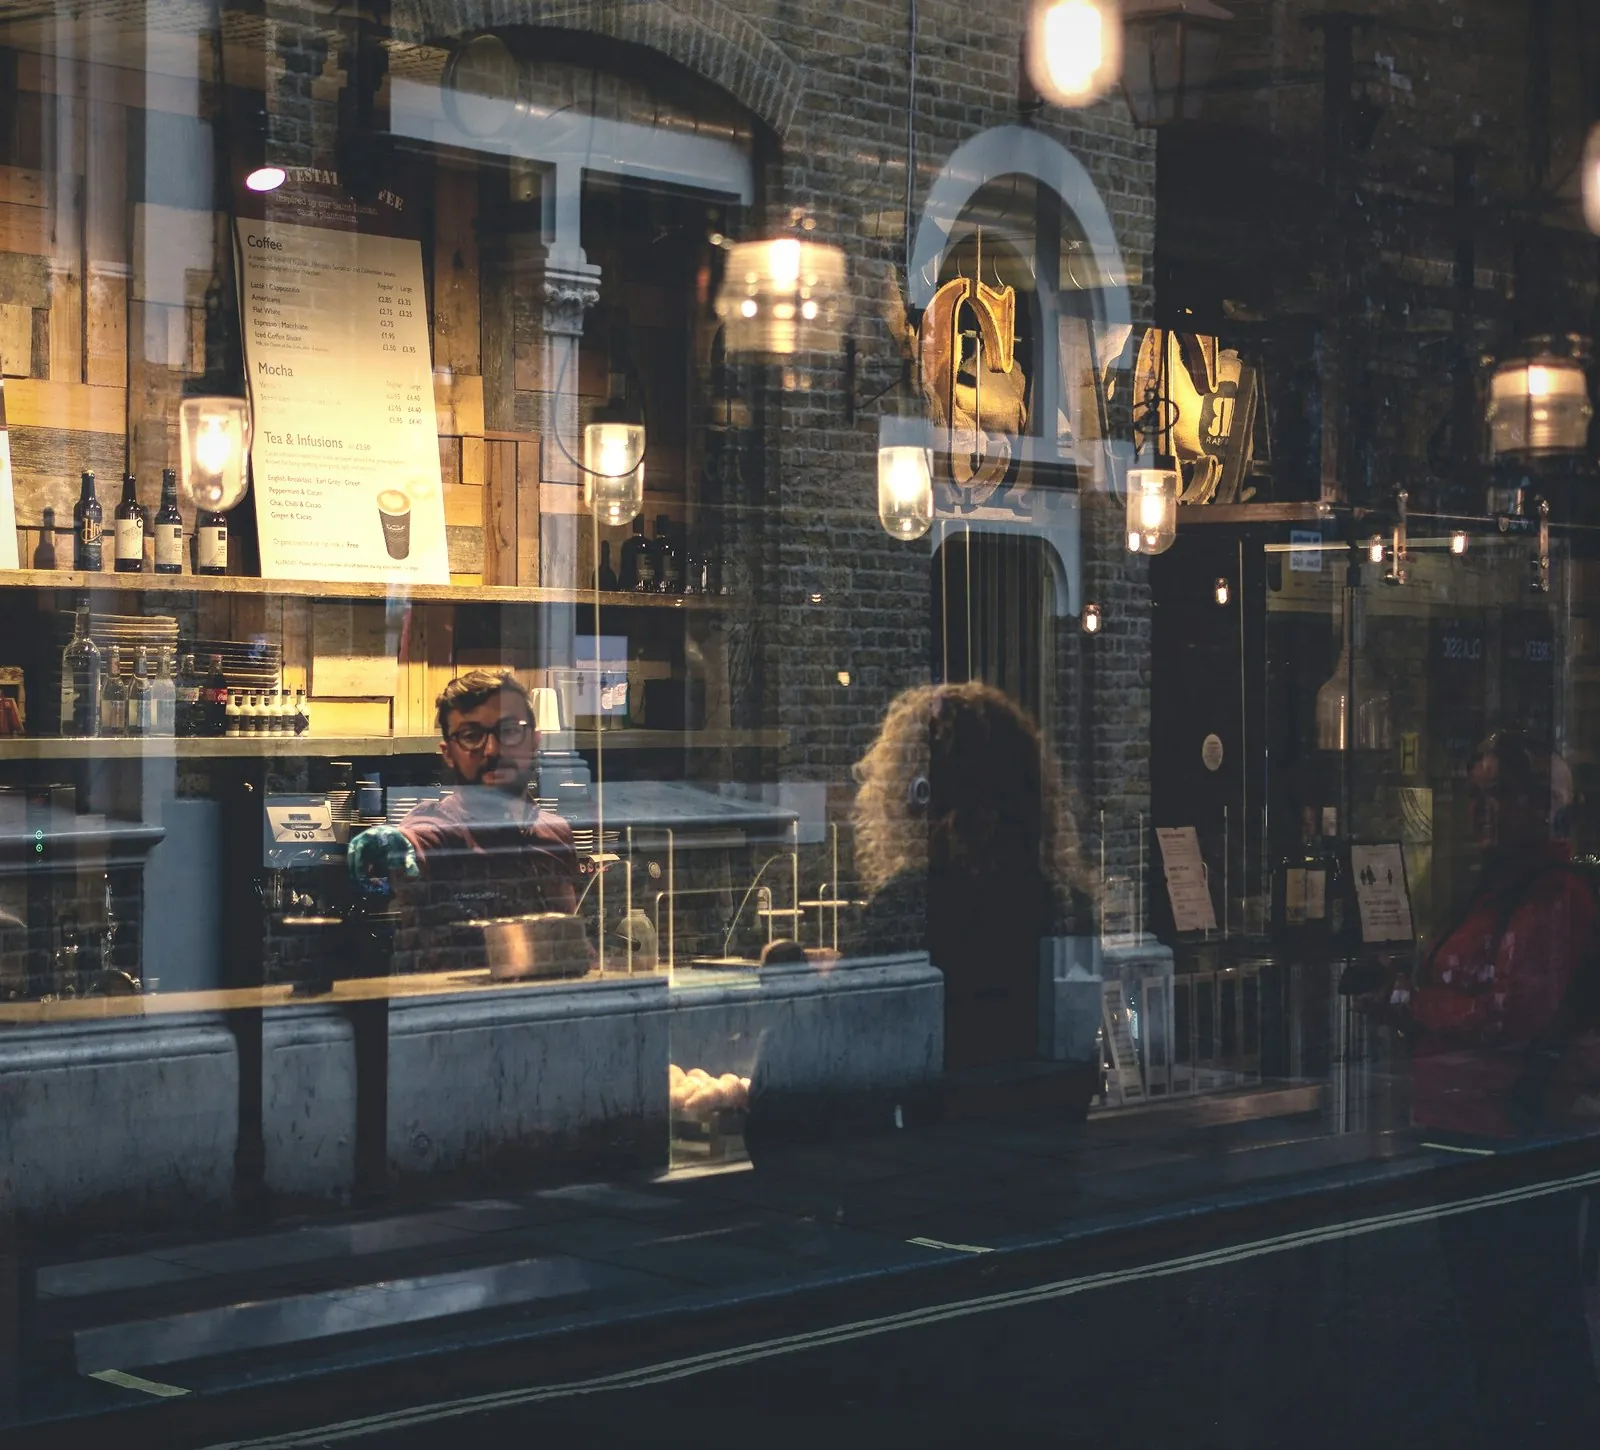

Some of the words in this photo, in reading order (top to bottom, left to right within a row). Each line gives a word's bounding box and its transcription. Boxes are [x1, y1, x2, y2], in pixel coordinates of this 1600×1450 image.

[247, 235, 283, 251] Coffee
[252, 295, 280, 304] Americano
[264, 307, 280, 315] White
[254, 320, 277, 329] Espresso
[281, 322, 308, 331] Macchiato
[258, 362, 293, 377] Mocha
[264, 431, 282, 445] Tea
[286, 434, 294, 446] &
[297, 435, 343, 449] Infusions
[268, 474, 286, 485] English
[269, 487, 300, 497] Peppermint
[305, 501, 321, 509] Cacao
[271, 511, 289, 521] Ginger
[296, 513, 312, 521] Cacao
